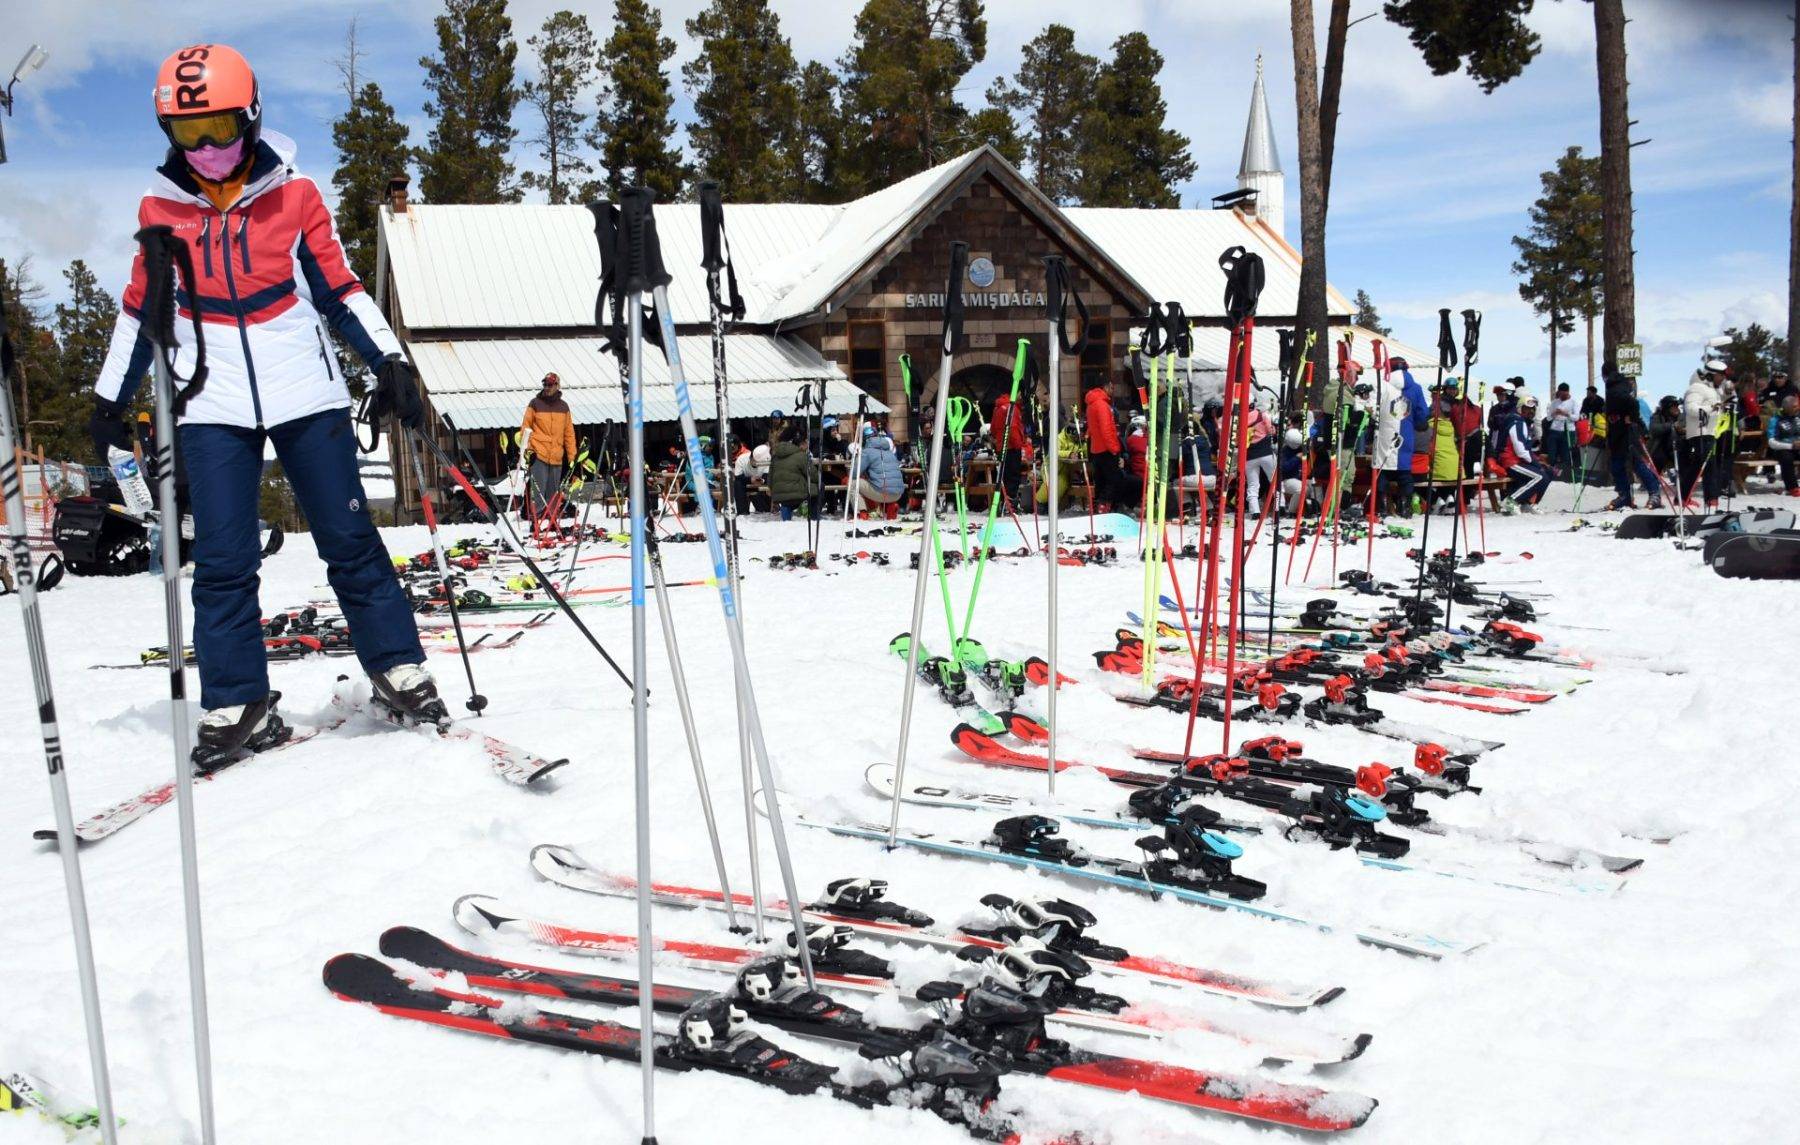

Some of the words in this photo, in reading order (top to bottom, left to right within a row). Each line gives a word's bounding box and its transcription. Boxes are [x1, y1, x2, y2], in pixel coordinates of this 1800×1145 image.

[175, 44, 213, 110] ROS
[1617, 348, 1640, 359] ORTA
[11, 535, 35, 586] KRC
[43, 736, 65, 775] 115
